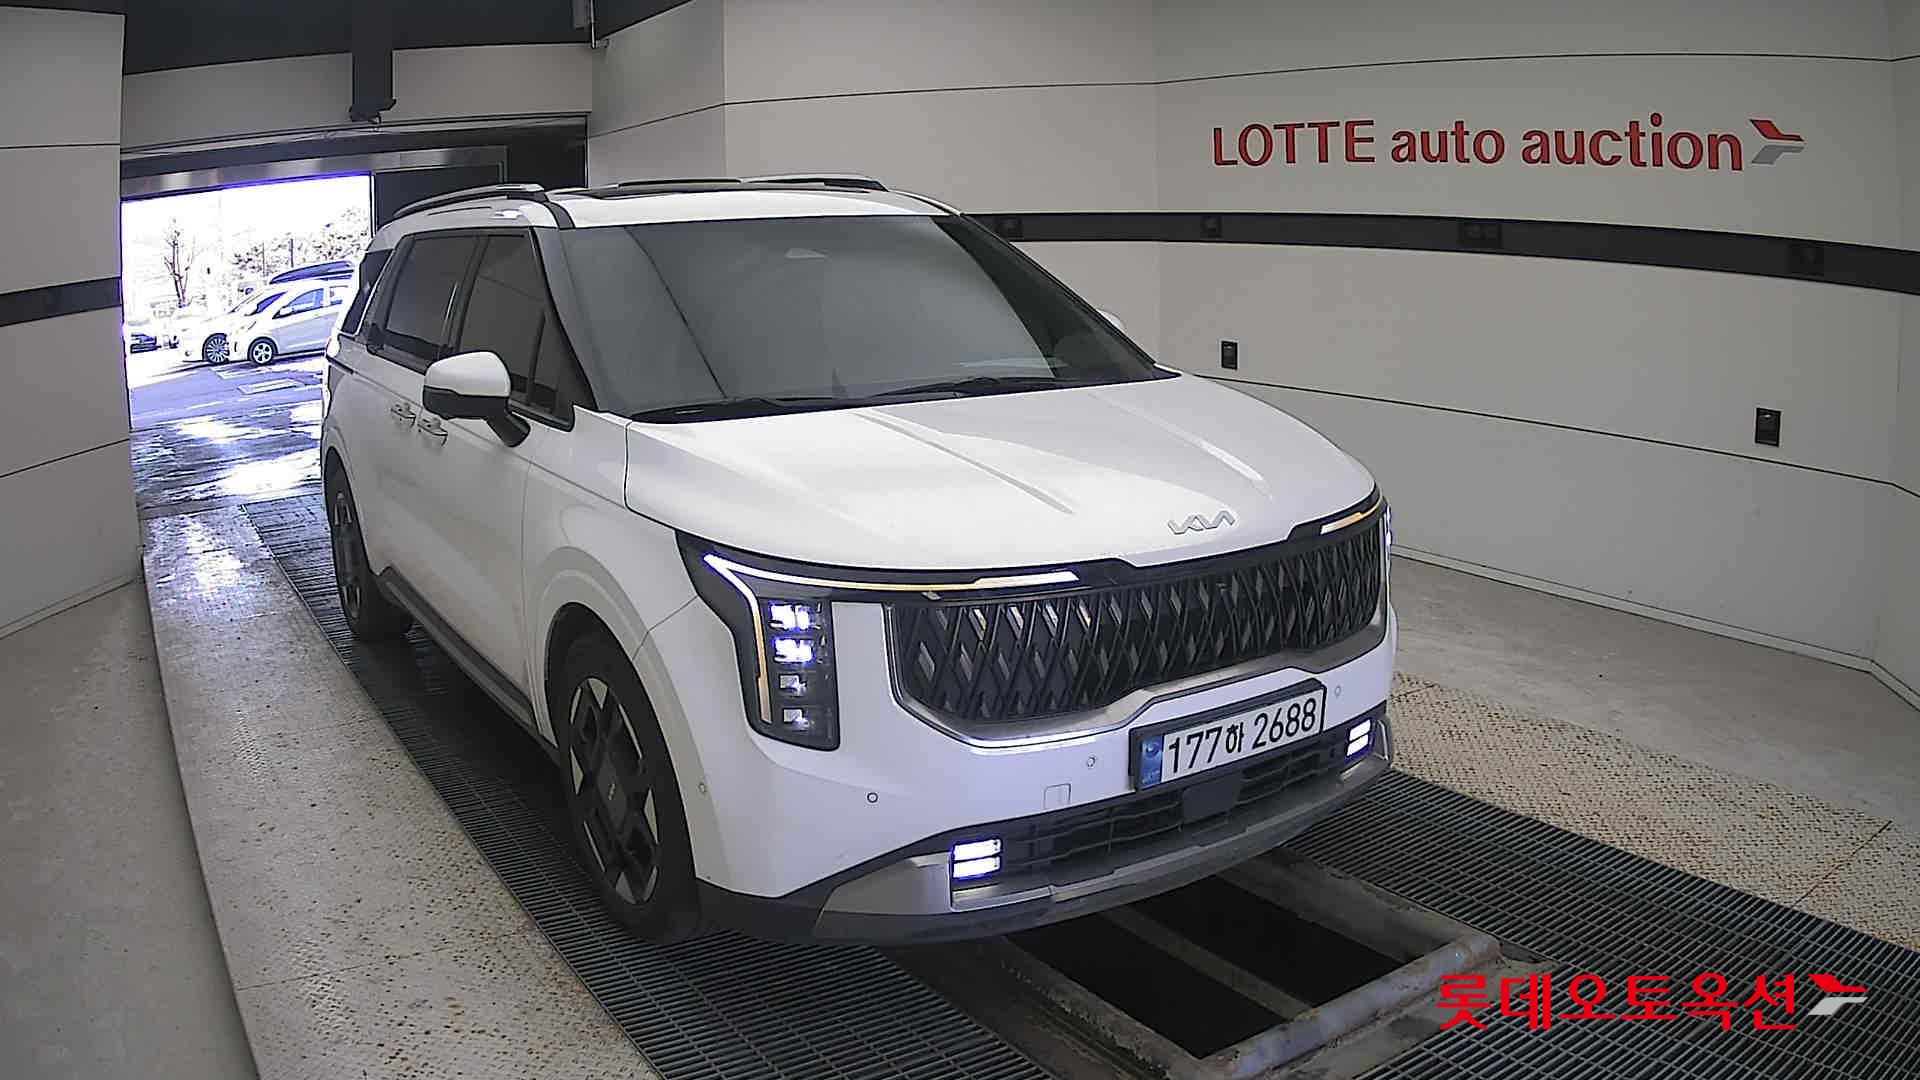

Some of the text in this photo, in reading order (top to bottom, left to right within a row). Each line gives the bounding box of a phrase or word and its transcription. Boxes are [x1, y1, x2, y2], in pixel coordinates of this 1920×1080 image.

[1212, 112, 1744, 171] LOTTE auto auction
[1168, 698, 1317, 774] 177하 2688
